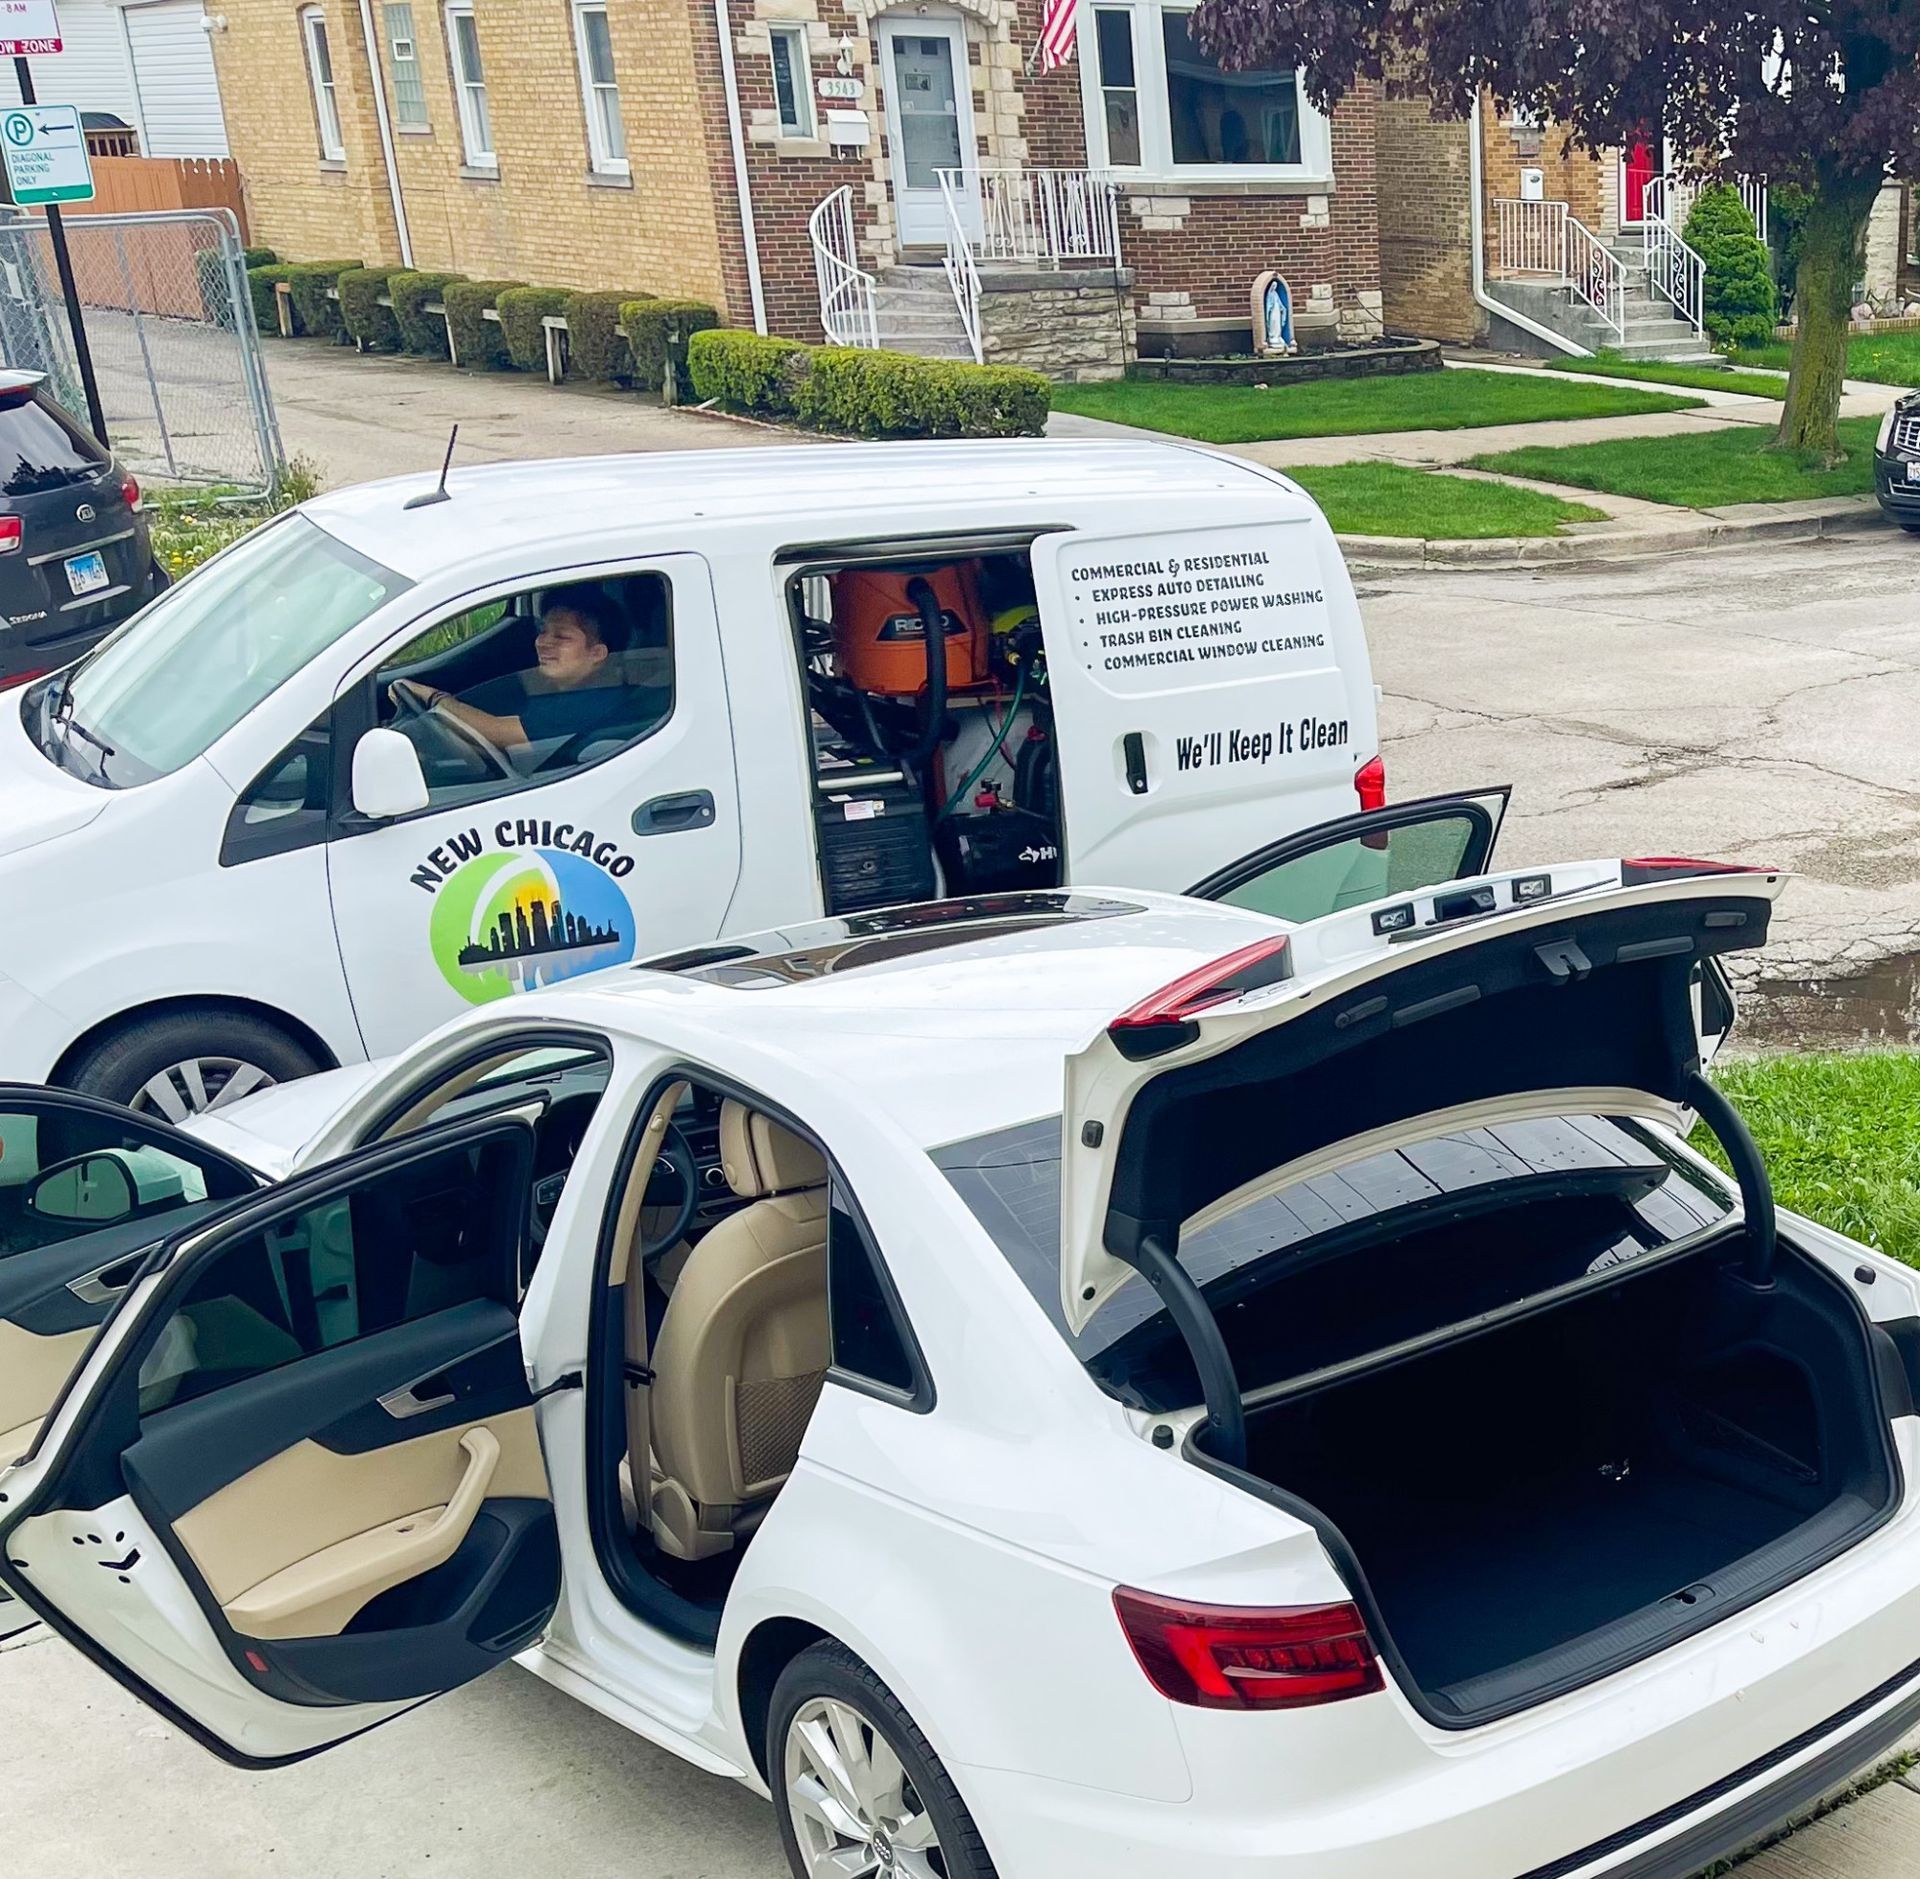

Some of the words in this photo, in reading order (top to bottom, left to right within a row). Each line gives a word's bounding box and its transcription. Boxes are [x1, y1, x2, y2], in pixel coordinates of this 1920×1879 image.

[20, 39, 57, 53] ZONE
[826, 81, 856, 96] 3543
[11, 152, 55, 163] DIAGONAL
[13, 163, 50, 174] PARKING
[15, 175, 37, 185] ONLY
[1071, 560, 1164, 581] COMMERCIAL
[1168, 558, 1180, 577] &
[1184, 551, 1270, 572] RESIDENTIAL
[1092, 584, 1153, 603] EXPRESS
[1157, 580, 1192, 597] AUTO
[1199, 573, 1265, 592] DETAILING
[1096, 601, 1207, 625] HIGH-PRESSURE
[1211, 596, 1259, 614] POWER
[1261, 590, 1323, 608] WASHING
[1099, 631, 1144, 648] TRASH
[1149, 627, 1173, 643] BIN
[1177, 620, 1242, 639] CLEANING
[1104, 648, 1195, 670] COMMERCIAL
[1198, 642, 1258, 660] WINDOW
[1261, 634, 1325, 653] CLEANING
[1176, 732, 1221, 771] We'll
[1228, 729, 1272, 764] Keep
[1279, 722, 1293, 754] It
[1300, 717, 1348, 751] Clean
[410, 828, 483, 893] NEW
[495, 819, 635, 878] CHICAGO
